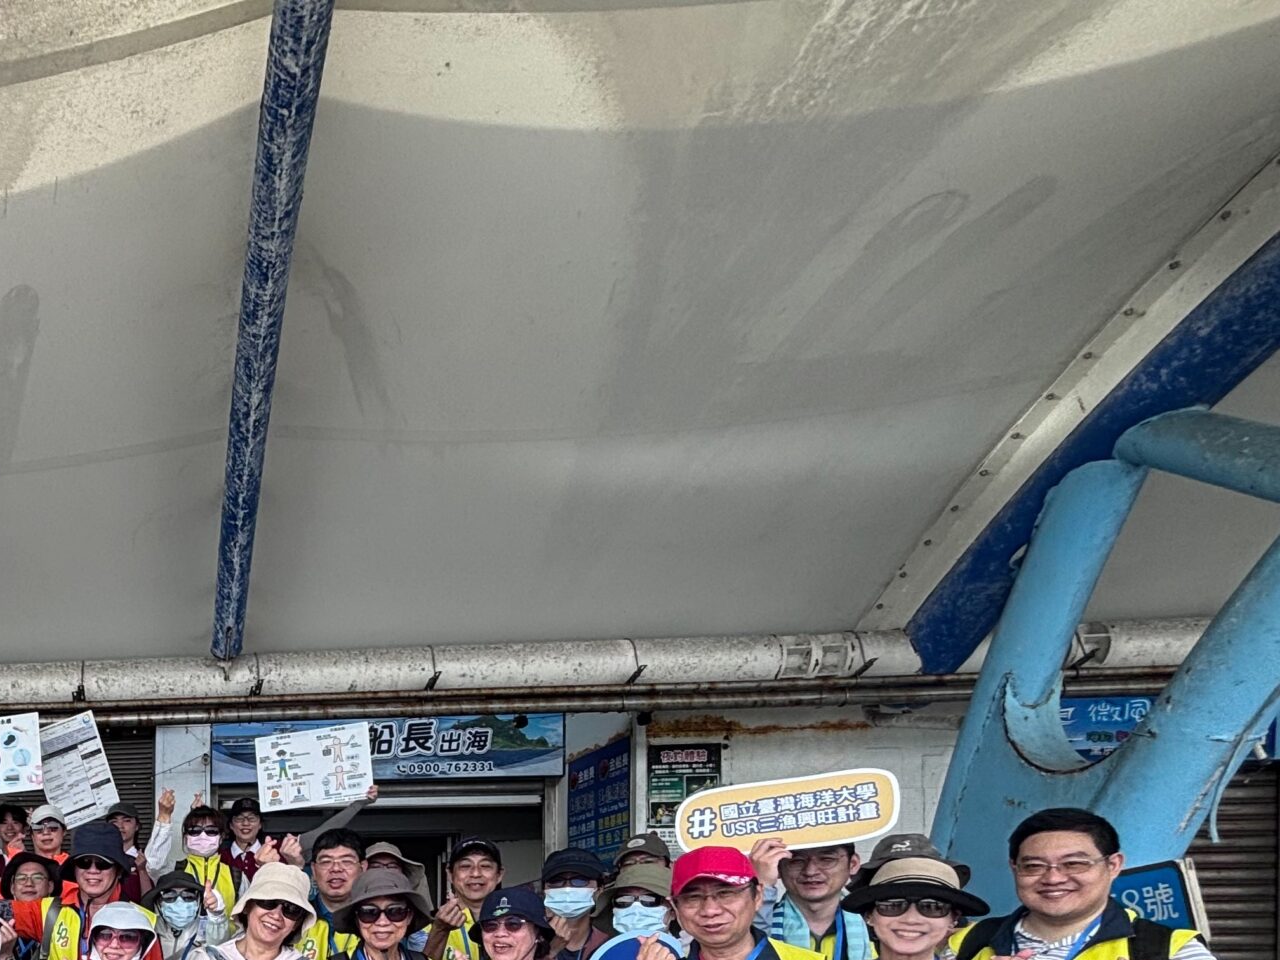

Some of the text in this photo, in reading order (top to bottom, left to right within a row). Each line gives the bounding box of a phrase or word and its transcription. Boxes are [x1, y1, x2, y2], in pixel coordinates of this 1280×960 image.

[368, 719, 492, 756] 船長出海
[408, 761, 495, 773] 0900-762331
[720, 783, 877, 821] 國立臺灣海洋大學
[721, 802, 879, 837] USR三漁興旺計畫
[1110, 882, 1180, 922] 8號
